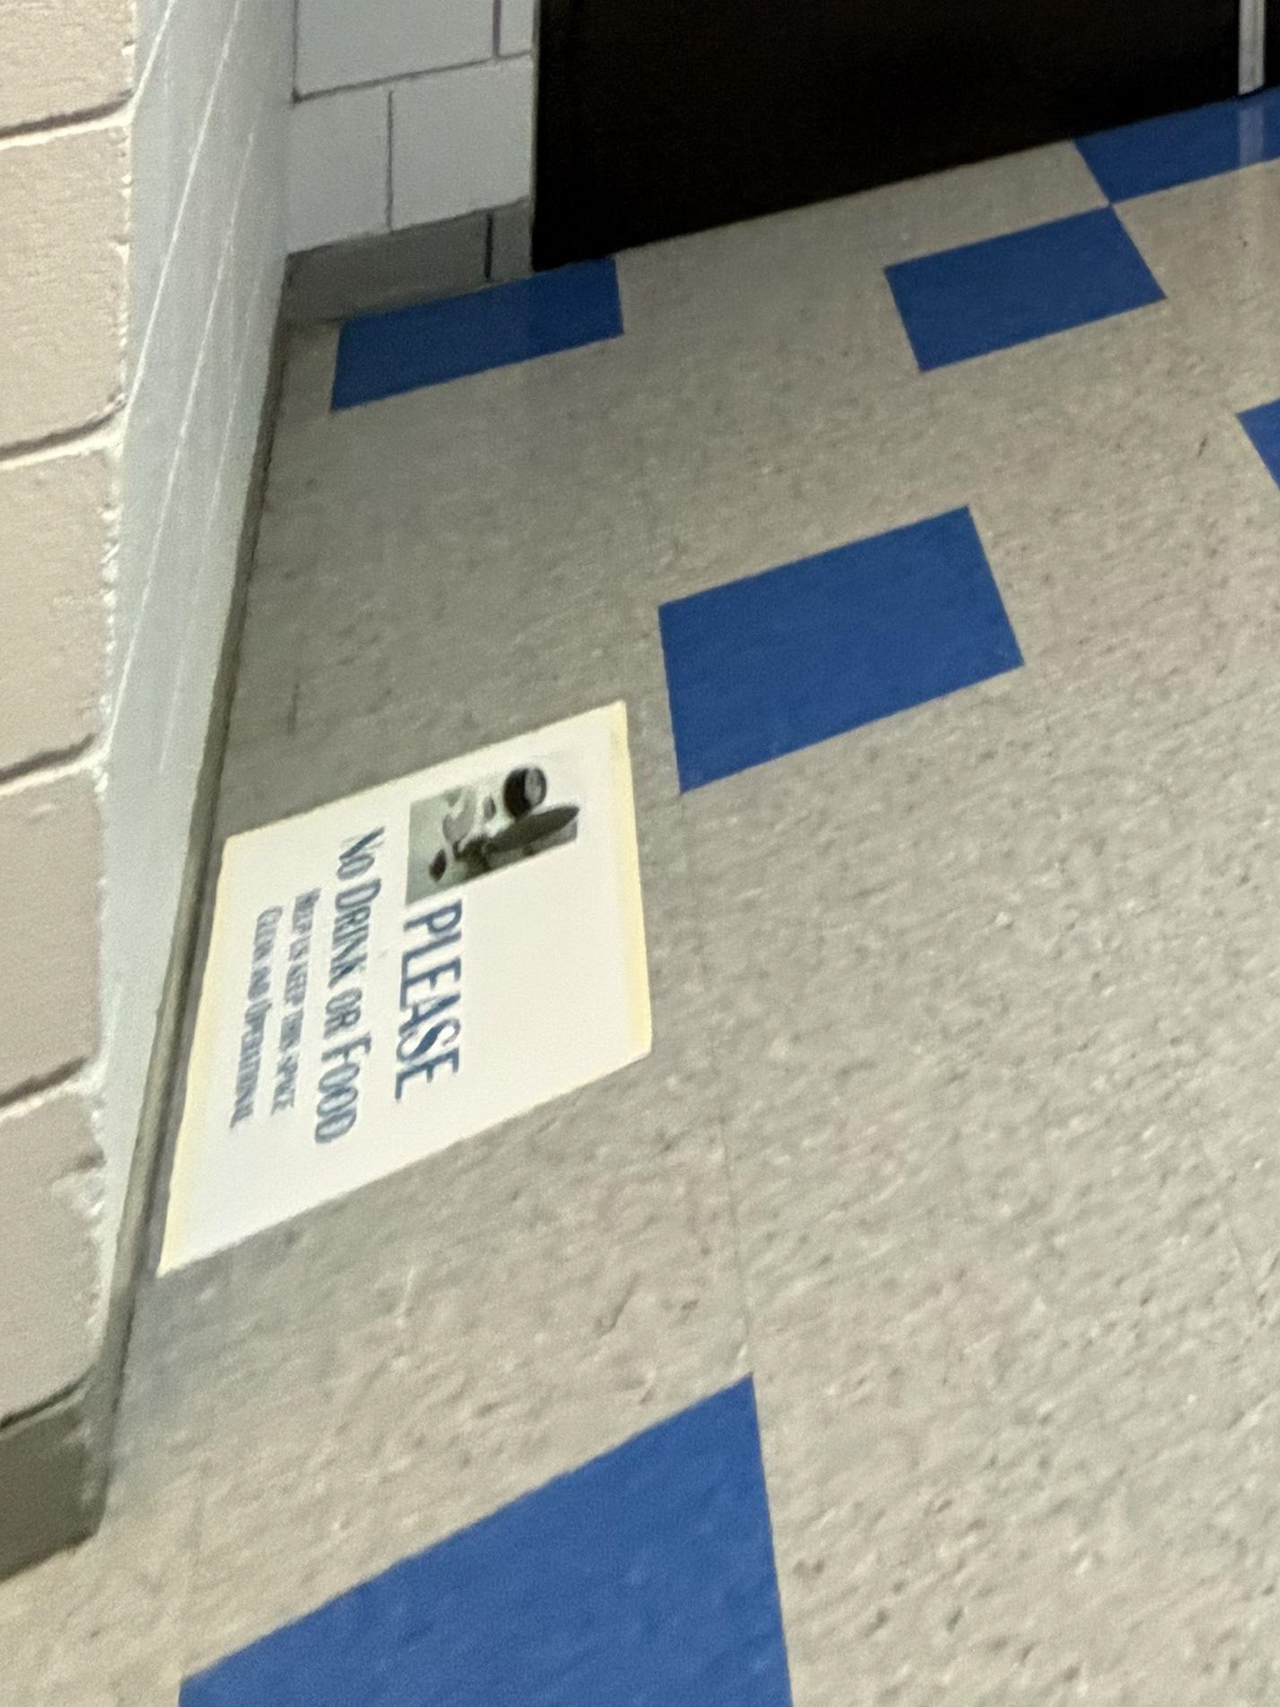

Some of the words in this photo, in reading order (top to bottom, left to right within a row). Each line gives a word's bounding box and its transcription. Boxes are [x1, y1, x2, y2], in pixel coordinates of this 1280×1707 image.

[327, 879, 382, 988] DRINK
[394, 898, 463, 1102] PLEASE
[313, 1033, 373, 1145] FOOD
